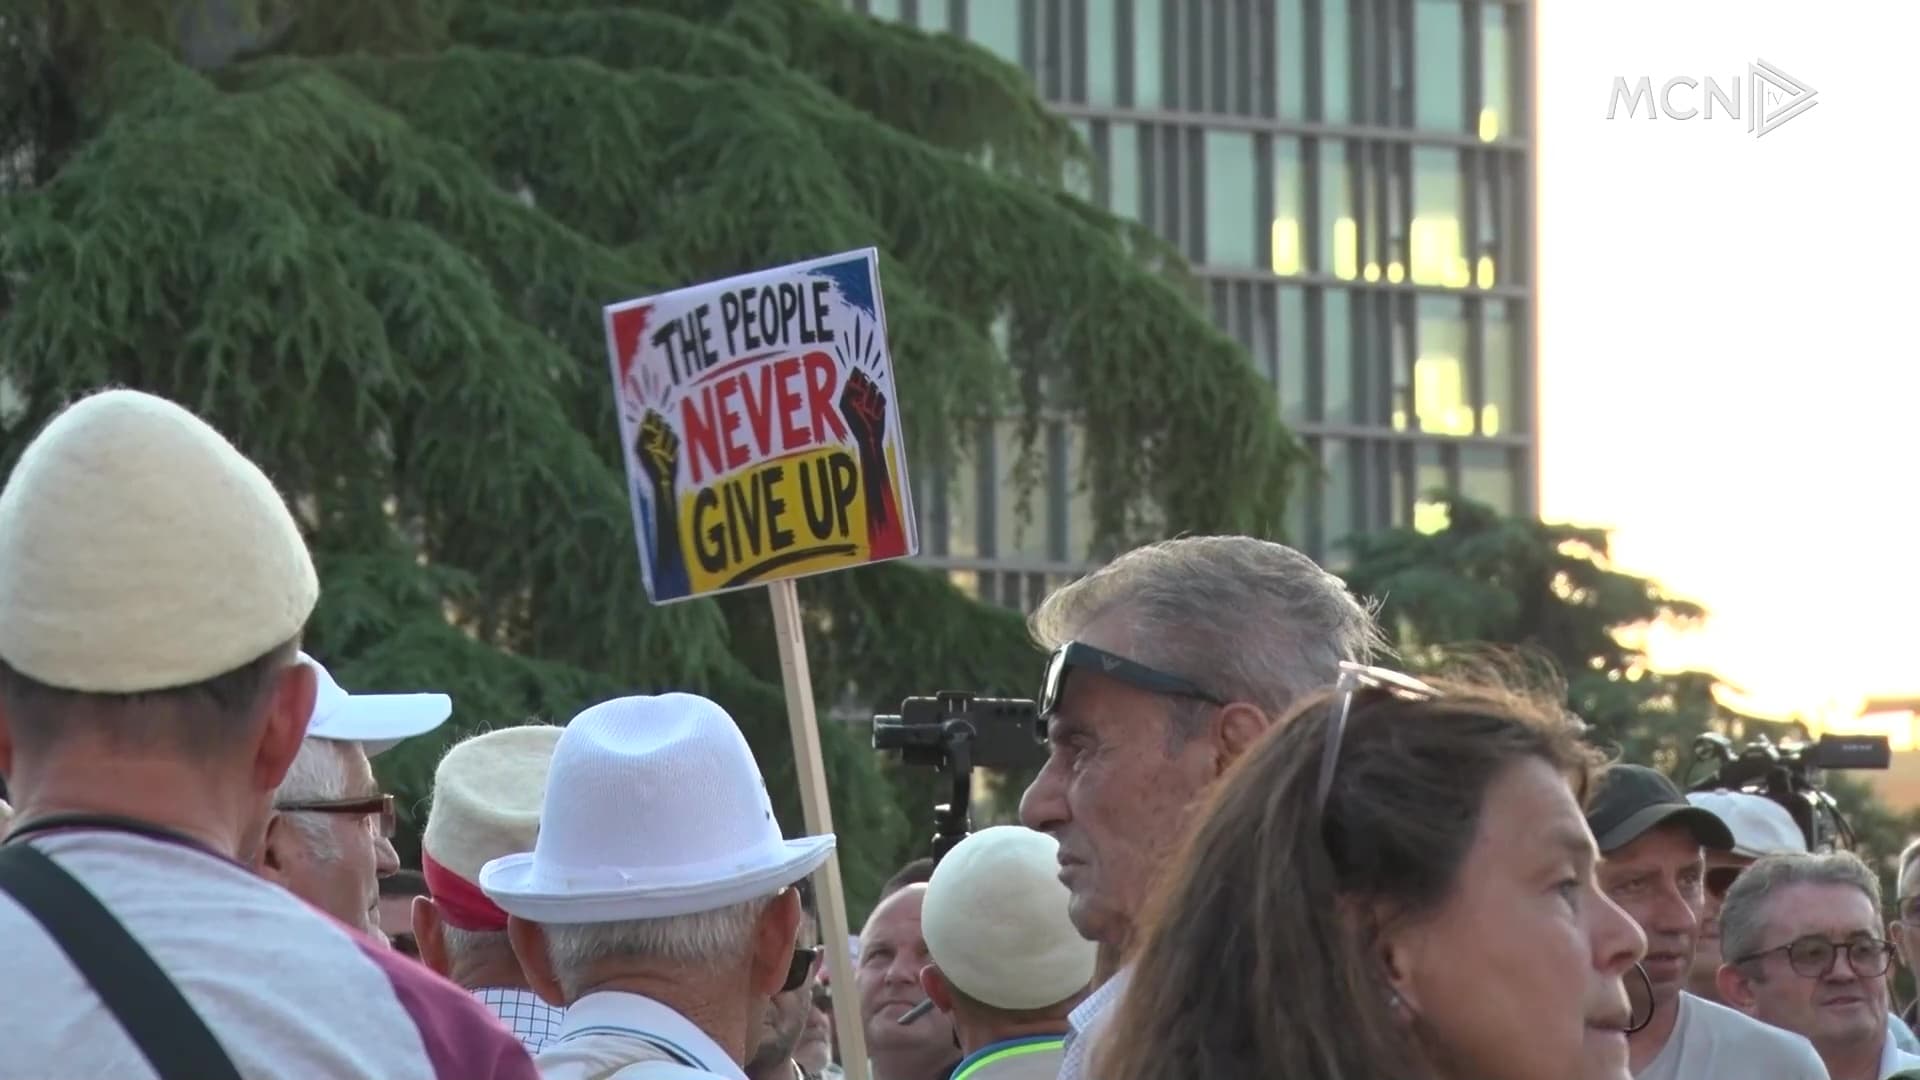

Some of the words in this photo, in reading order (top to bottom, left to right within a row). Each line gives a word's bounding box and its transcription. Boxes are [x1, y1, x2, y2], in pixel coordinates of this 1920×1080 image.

[652, 303, 718, 385] THE
[720, 281, 835, 356] PEOPLE
[680, 351, 848, 484] NEVER
[692, 462, 795, 574] GIVE
[800, 452, 858, 540] UP
